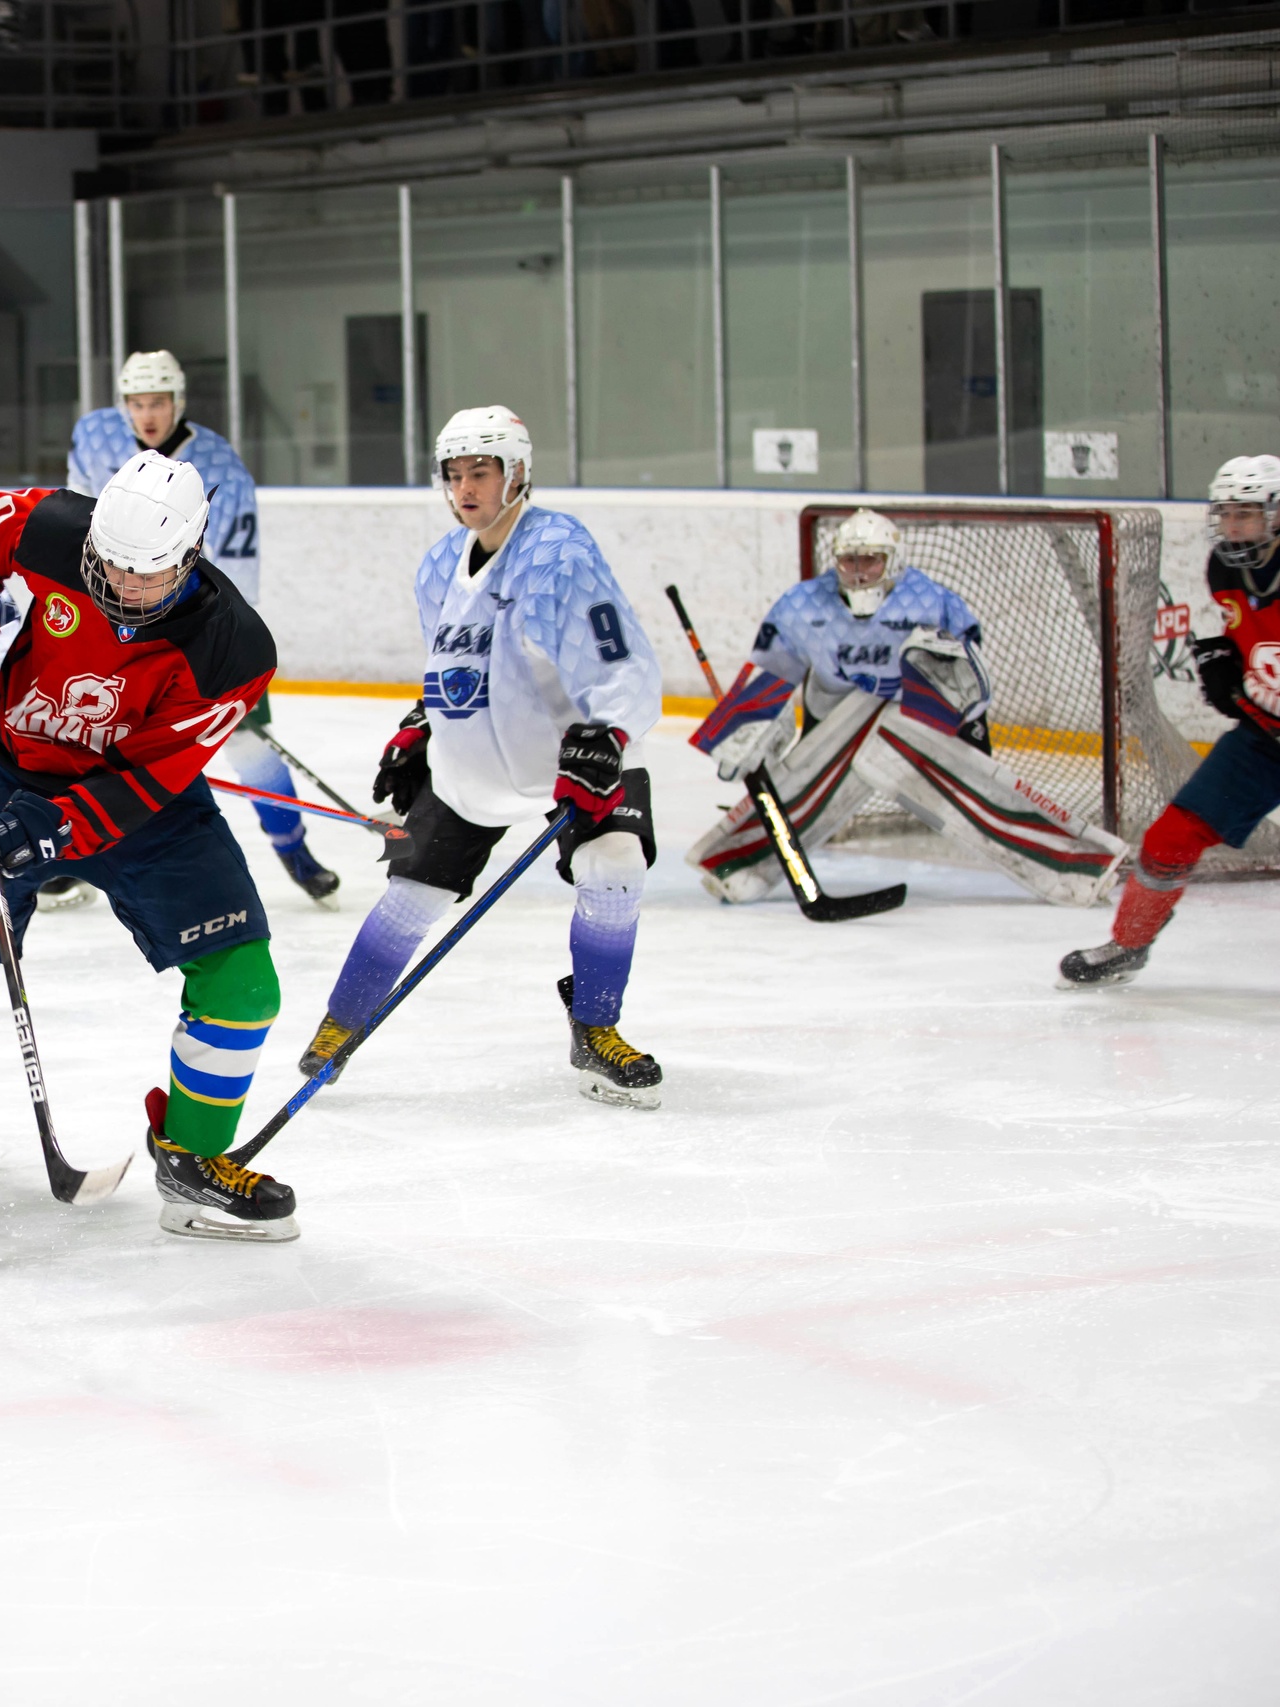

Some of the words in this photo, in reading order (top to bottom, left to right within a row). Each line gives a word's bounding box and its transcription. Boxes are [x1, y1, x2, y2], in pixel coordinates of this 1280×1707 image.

[587, 601, 630, 663] 9
[170, 699, 247, 748] 70
[1015, 778, 1072, 824] VAUGHN
[179, 909, 247, 945] CCM
[12, 1006, 45, 1104] BAUER
